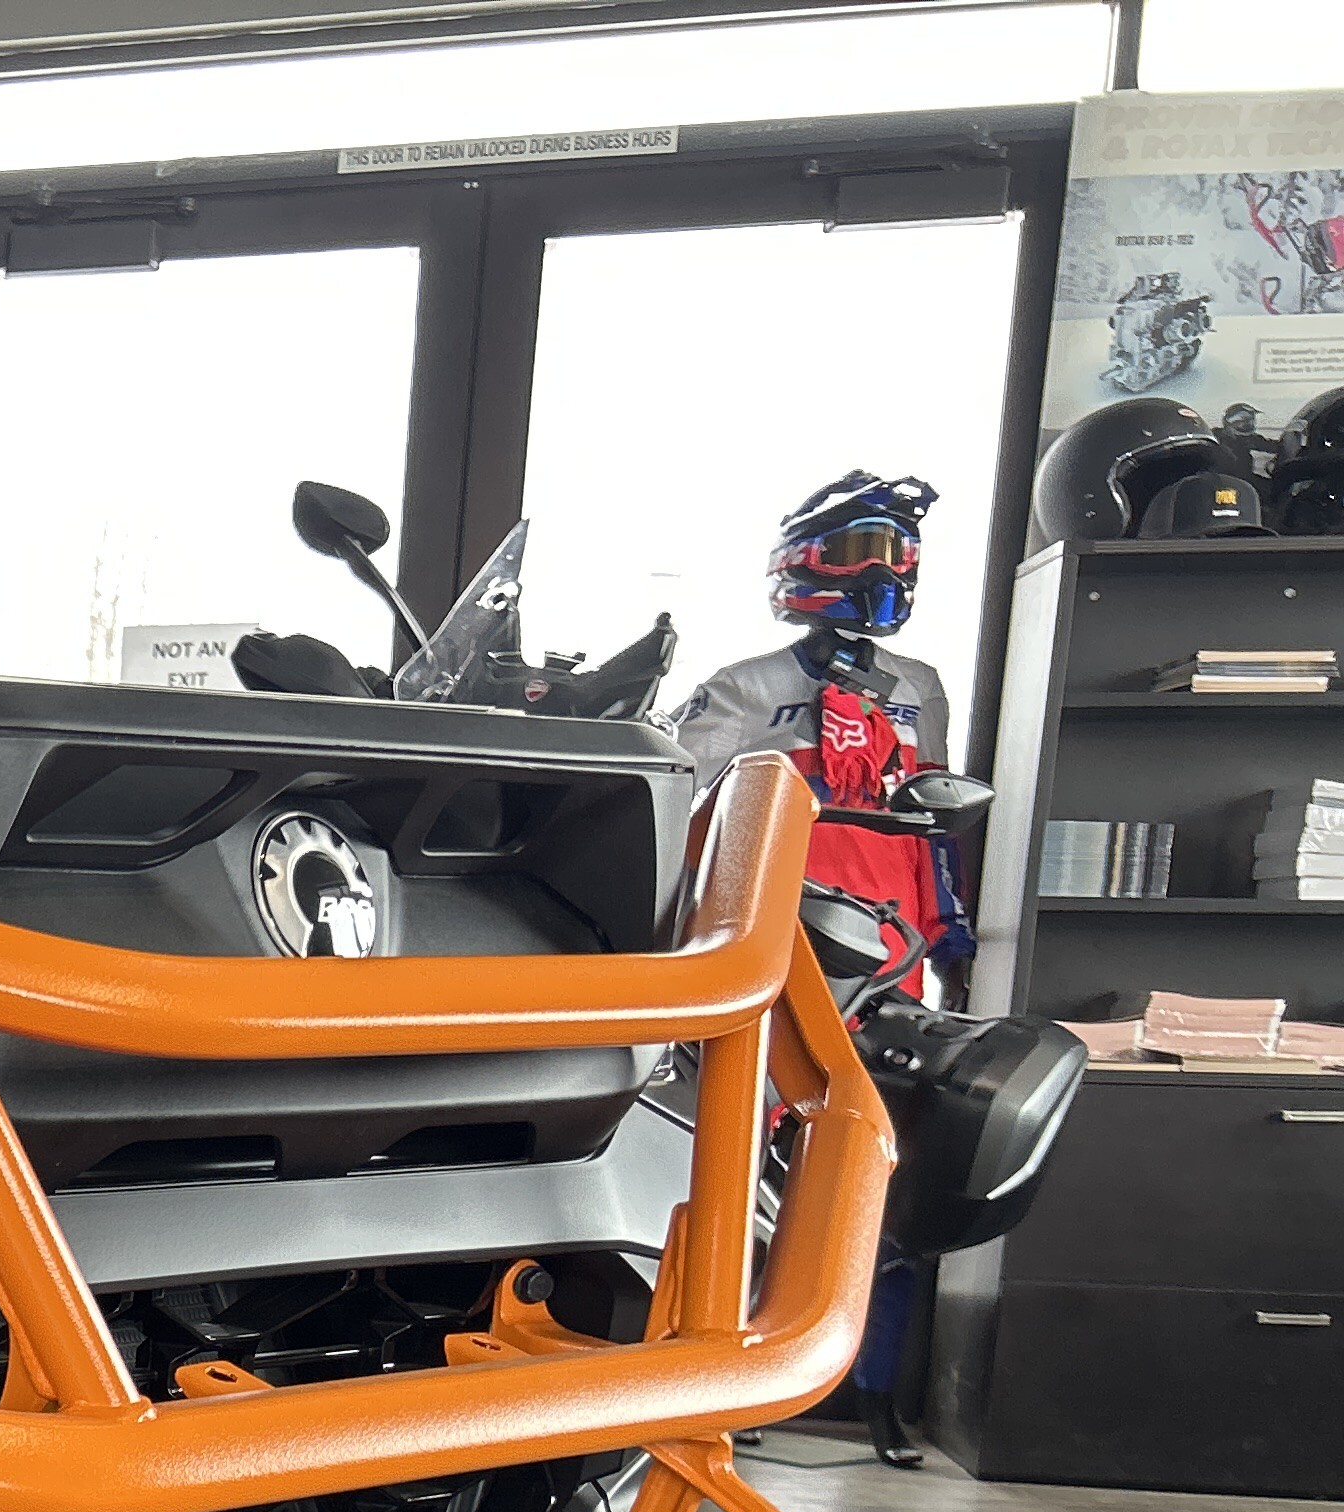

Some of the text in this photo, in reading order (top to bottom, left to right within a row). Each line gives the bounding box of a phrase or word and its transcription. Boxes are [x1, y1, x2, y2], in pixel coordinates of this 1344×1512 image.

[346, 130, 672, 167] THIS DOOR TO REMAIN UNLOCKED DURING BUSINESS HOURS
[152, 639, 227, 660] NOT AN
[167, 671, 209, 688] EXIT
